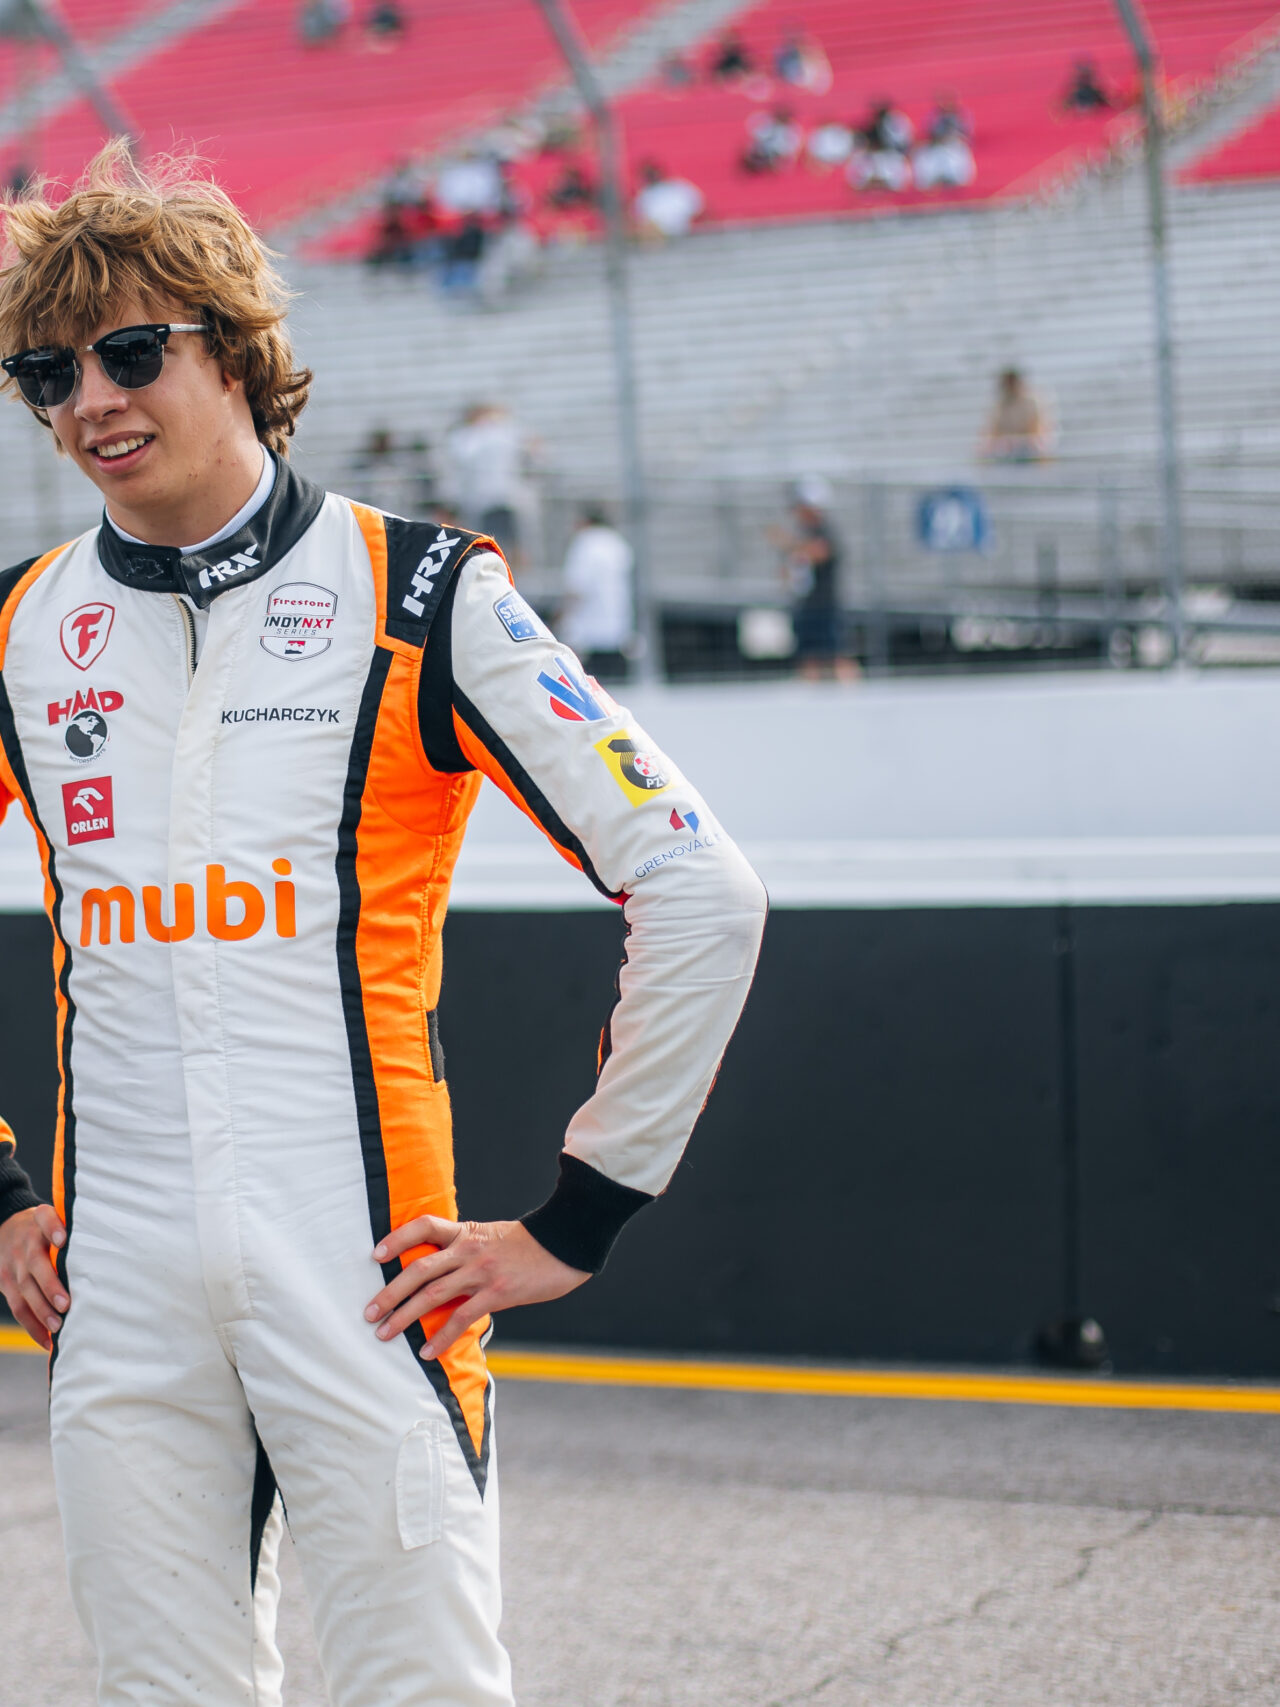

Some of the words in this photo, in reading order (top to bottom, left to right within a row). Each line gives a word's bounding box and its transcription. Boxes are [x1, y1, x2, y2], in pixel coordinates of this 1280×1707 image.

[199, 543, 261, 589] HRX
[402, 528, 461, 618] HRX
[273, 597, 331, 608] Firestone
[276, 628, 317, 636] SERIES
[47, 687, 125, 726] HMD
[221, 707, 341, 725] KUCHARCZYK
[70, 817, 109, 835] ORLEN
[79, 857, 297, 948] mubi
